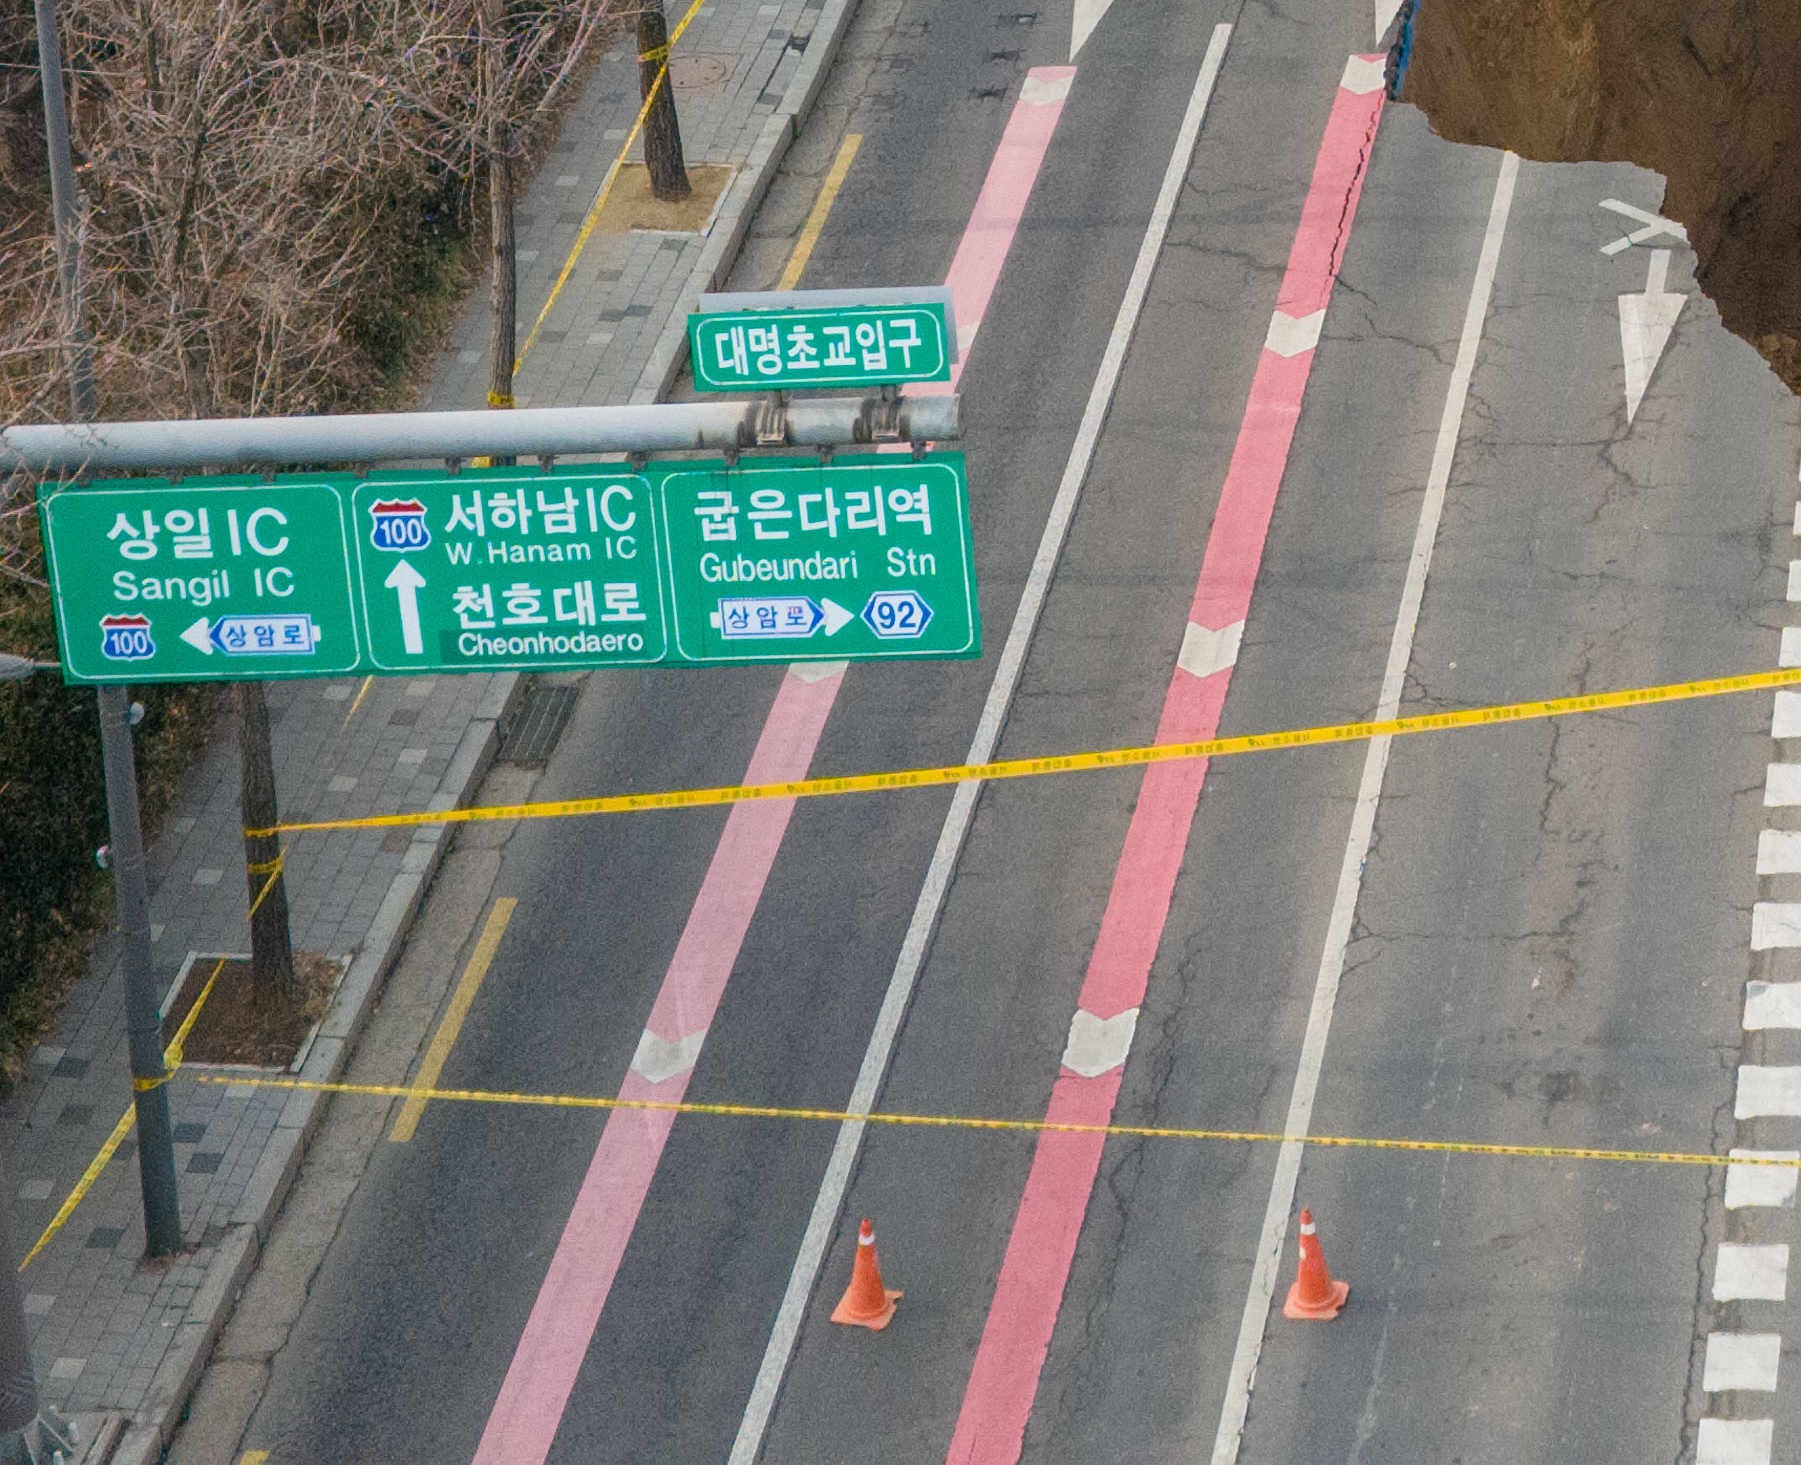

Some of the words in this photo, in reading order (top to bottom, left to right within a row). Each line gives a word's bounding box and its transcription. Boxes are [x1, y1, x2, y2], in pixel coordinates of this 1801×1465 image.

[714, 318, 922, 376] 대명초교입구
[693, 483, 933, 542] 굽은다리역
[380, 517, 423, 545] 100
[605, 535, 637, 559] IC
[699, 550, 858, 582] Gubeundari
[886, 546, 936, 577] Stn
[112, 569, 230, 607] Sangil
[254, 566, 295, 597] IC
[452, 580, 647, 630] 천호대로
[877, 600, 917, 629] 92
[110, 630, 148, 655] 100
[225, 623, 305, 648] 상암로
[457, 629, 644, 657] Cheonhodaero
